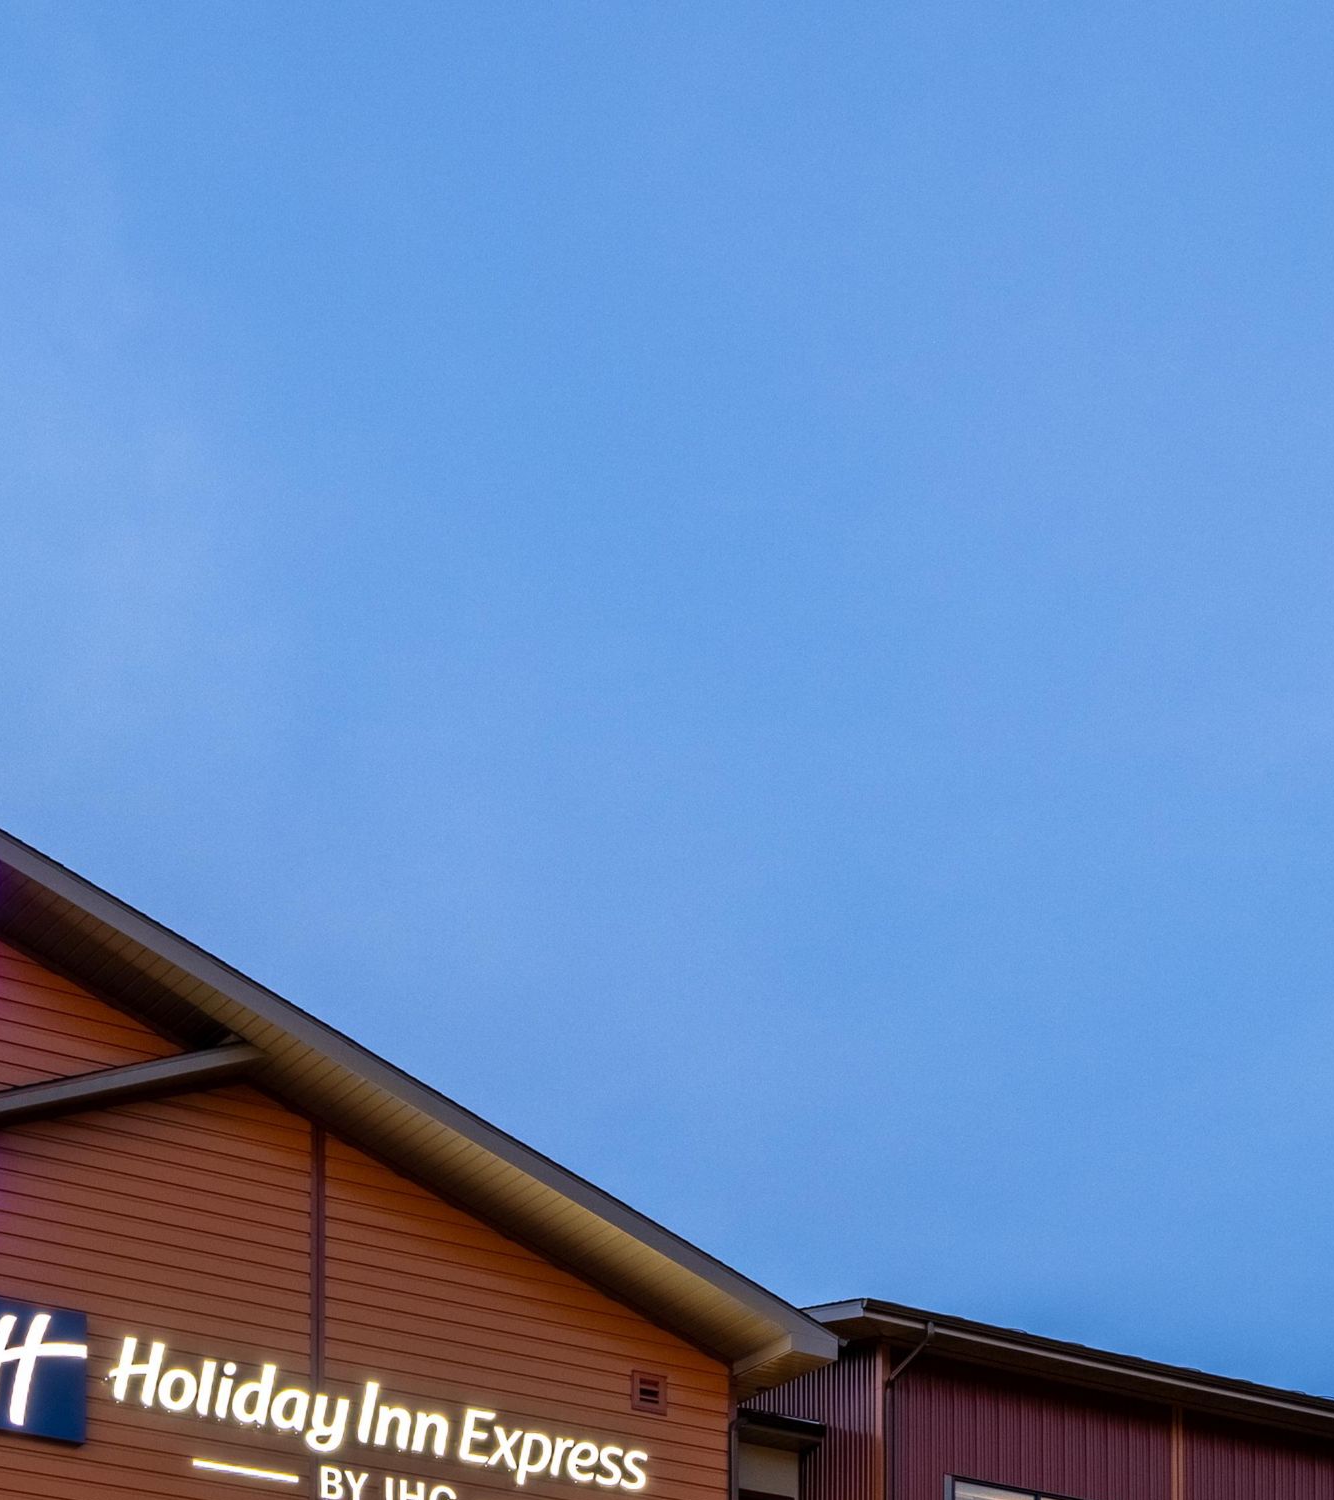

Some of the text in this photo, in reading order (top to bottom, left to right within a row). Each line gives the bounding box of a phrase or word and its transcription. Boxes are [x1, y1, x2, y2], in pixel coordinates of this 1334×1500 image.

[109, 1335, 648, 1491] Holiday Inn Express
